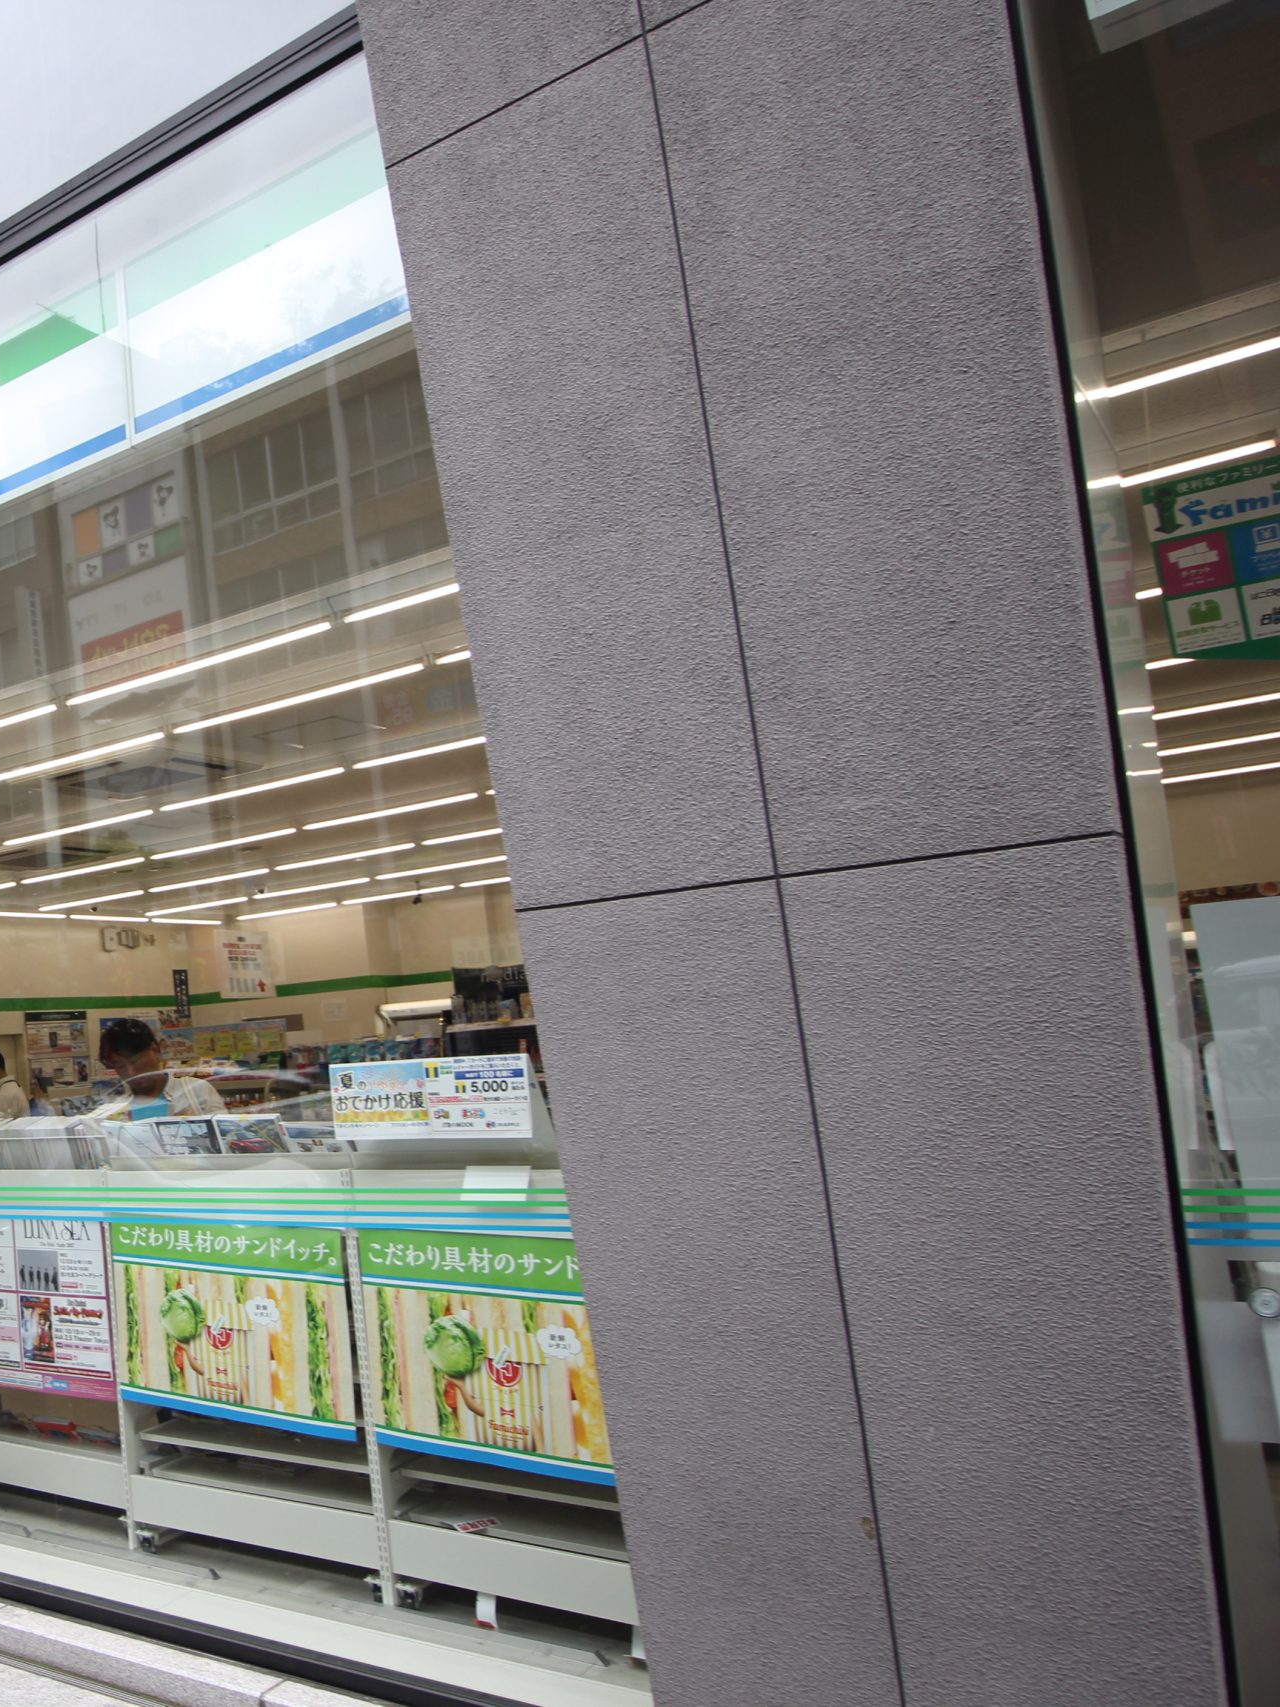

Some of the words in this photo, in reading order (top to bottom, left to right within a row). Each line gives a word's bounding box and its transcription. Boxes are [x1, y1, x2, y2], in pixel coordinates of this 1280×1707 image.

[471, 1080, 508, 1093] 5,000
[23, 1219, 58, 1240] LUNA
[118, 1225, 338, 1266] こだわり具材のサンドイッチ。
